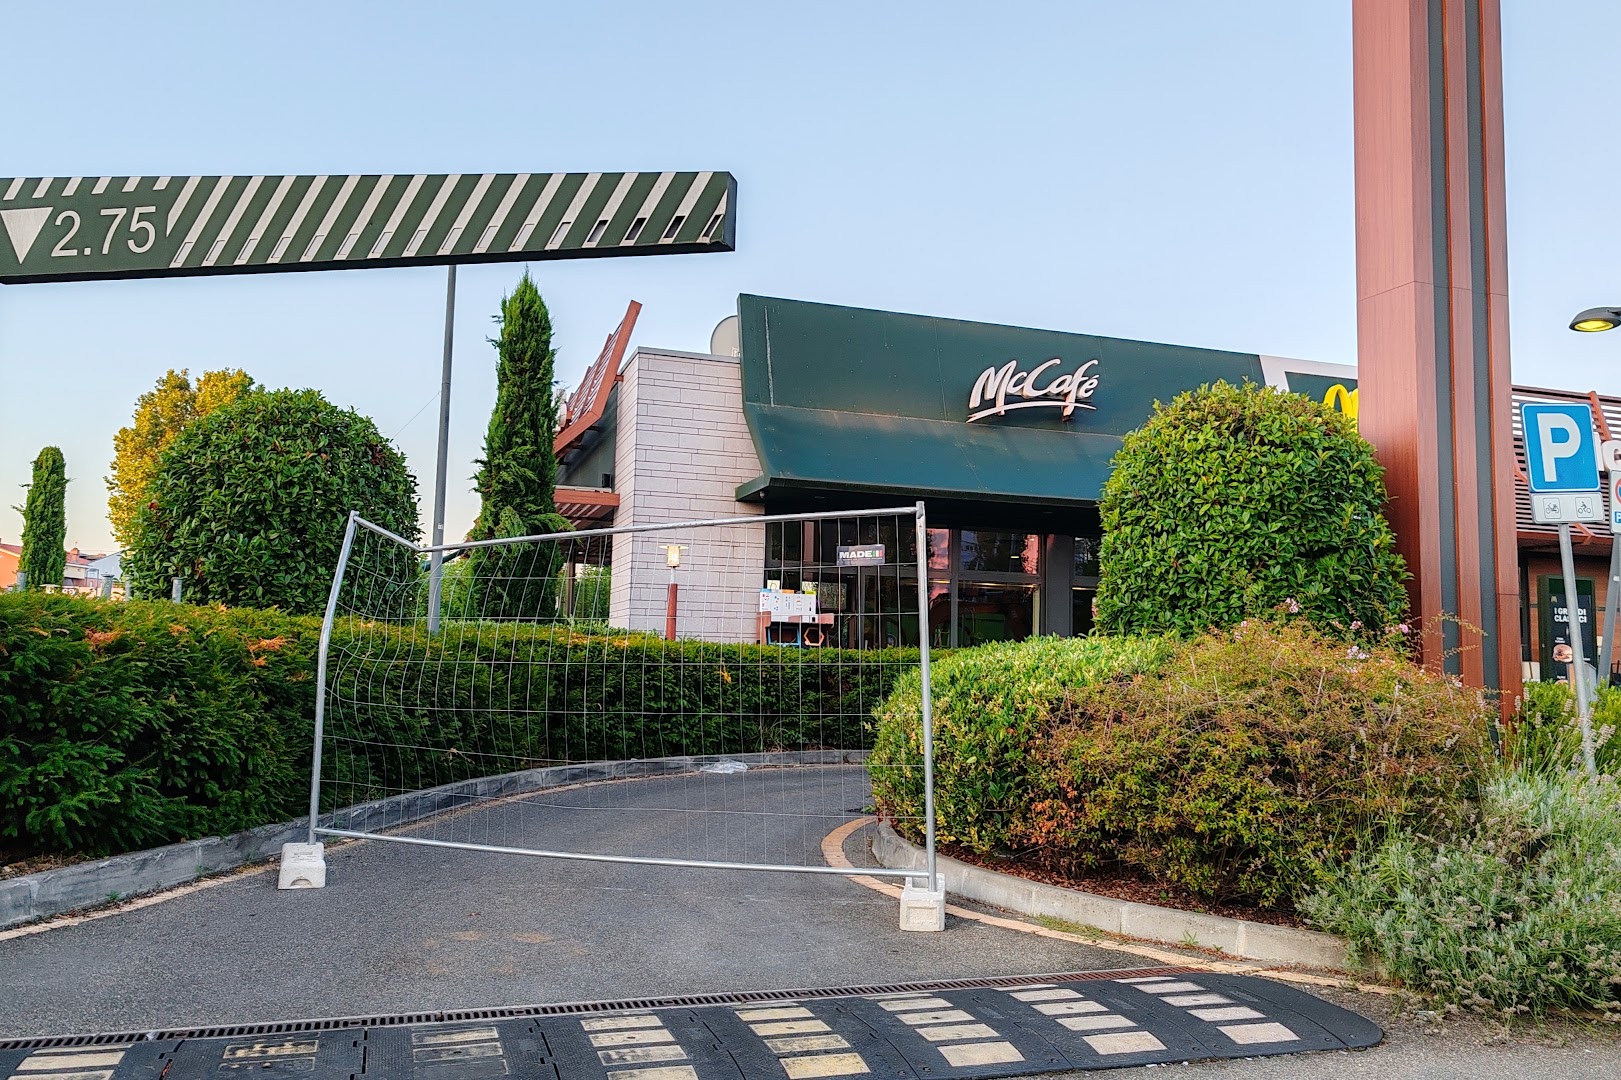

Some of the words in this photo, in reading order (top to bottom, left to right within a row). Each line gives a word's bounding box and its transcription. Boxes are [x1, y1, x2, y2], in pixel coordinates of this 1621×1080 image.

[51, 205, 156, 257] 2.75
[968, 358, 1100, 416] McCafé
[1536, 412, 1582, 482] P
[839, 550, 872, 559] MADE
[1554, 615, 1587, 623] CLACI
[1557, 607, 1587, 616] GRDI
